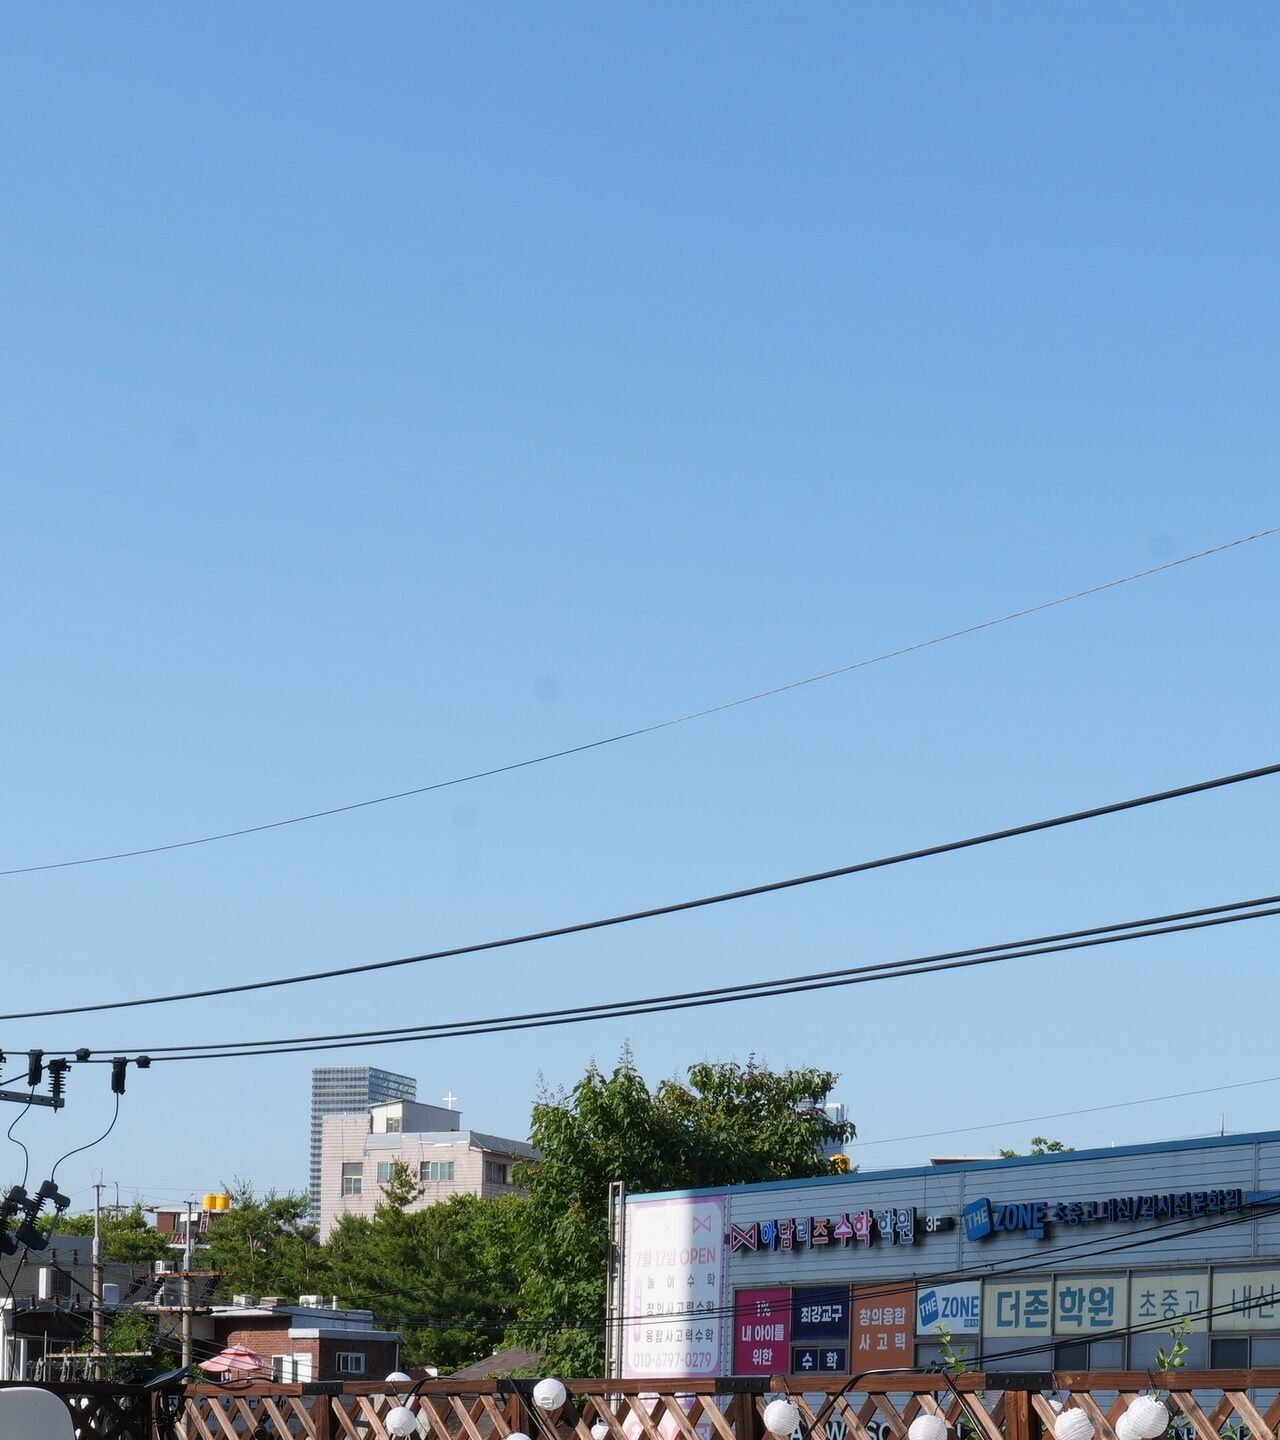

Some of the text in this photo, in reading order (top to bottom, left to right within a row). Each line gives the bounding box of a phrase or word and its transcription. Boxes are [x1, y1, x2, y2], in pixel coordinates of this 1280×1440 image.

[926, 1215, 942, 1232] 3F
[965, 1207, 989, 1229] THE
[993, 1202, 1046, 1231] ZONE
[680, 1248, 716, 1265] OPEN
[920, 1295, 979, 1318] THE ZONE
[1139, 1290, 1201, 1320] 초중고
[1231, 1284, 1275, 1319] 내신
[801, 1305, 842, 1323] 최강교구
[859, 1307, 907, 1326] 창의융합
[646, 1328, 714, 1343] 융합사고력수학
[742, 1324, 784, 1341] 내 아이를
[633, 1352, 712, 1368] 010-6797-0279
[752, 1349, 773, 1365] 위한
